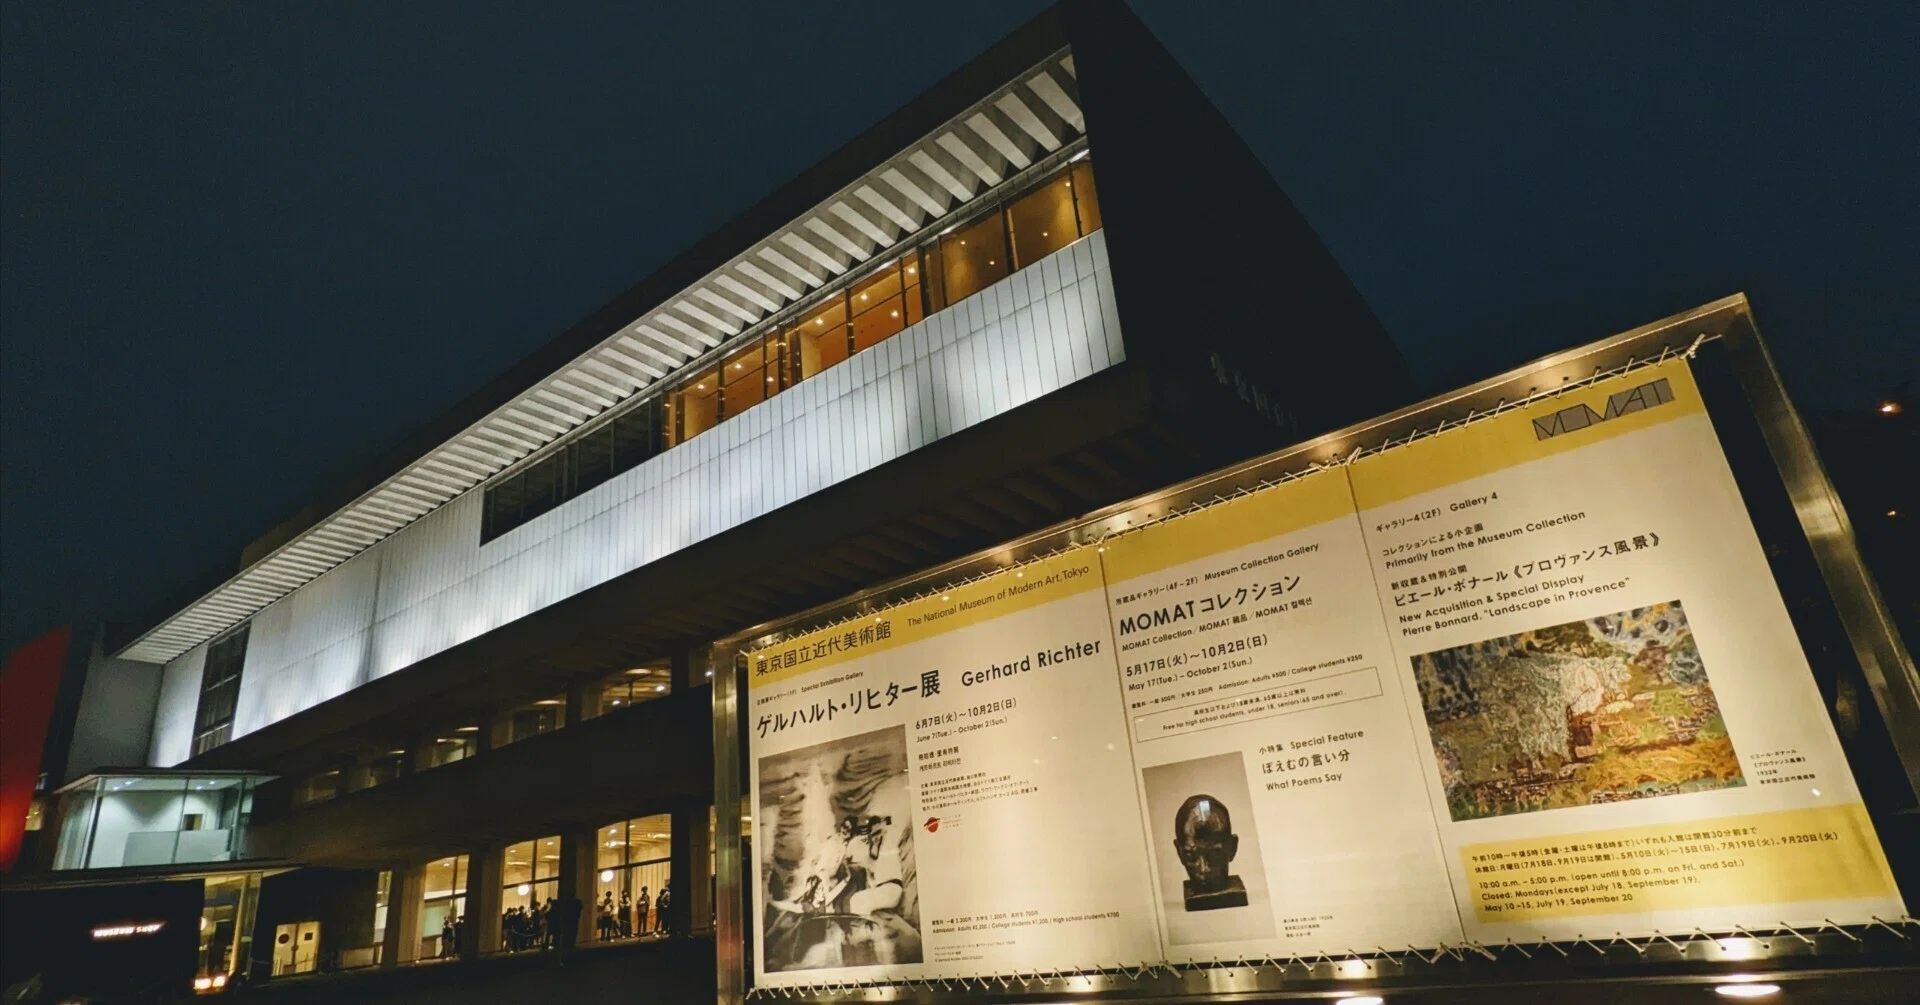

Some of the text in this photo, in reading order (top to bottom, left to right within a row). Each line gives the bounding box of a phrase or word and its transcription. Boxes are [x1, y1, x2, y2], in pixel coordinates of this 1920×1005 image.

[1450, 492, 1498, 512] Gallery 4
[1386, 511, 1586, 570] Primarily from the Museum Collection
[1204, 543, 1319, 581] Museum Collection Gallery
[907, 618, 922, 627] The
[924, 605, 957, 622] National
[959, 595, 995, 611] Museum
[997, 589, 1006, 600] of
[1008, 579, 1043, 596] Modern
[1400, 574, 1584, 624] New Acquisition & Special Display
[1122, 637, 1150, 652] MOMAT
[1152, 628, 1192, 644] Collection
[1199, 618, 1230, 632] MOMAT
[1256, 604, 1288, 618] MOMAT
[1402, 622, 1432, 636] Pierre
[1554, 593, 1564, 602] in
[756, 621, 891, 677] 東京国立近代美術館
[961, 640, 1100, 686] Gerhard Richter
[1128, 682, 1144, 692] May
[1187, 664, 1220, 678] October
[1292, 664, 1316, 675] College
[1318, 658, 1345, 668] students
[757, 670, 940, 738] ゲルハルト・リヒター展
[916, 734, 930, 742] June
[958, 723, 984, 734] October
[1200, 715, 1218, 724] school
[1290, 730, 1364, 750] Special Feature
[1266, 773, 1342, 790] What Poems Say
[1480, 881, 1500, 889] 10:00
[1502, 879, 1520, 887] a.m.
[1530, 876, 1548, 884] 5:00
[1550, 875, 1569, 884] p.m.
[1571, 872, 1598, 882] (open
[1600, 869, 1620, 878] until
[1622, 868, 1640, 877] 8:00
[1644, 867, 1665, 875] p.m.
[1682, 864, 1696, 872] Fri.
[1700, 861, 1718, 870] and
[1722, 859, 1744, 868] Sat.)
[1482, 890, 1512, 900] Closed:
[1592, 883, 1608, 892] July
[1628, 878, 1679, 890] September
[1485, 904, 1502, 912] May
[1536, 900, 1552, 910] July
[1571, 895, 1620, 906] September
[1622, 893, 1632, 901] 20
